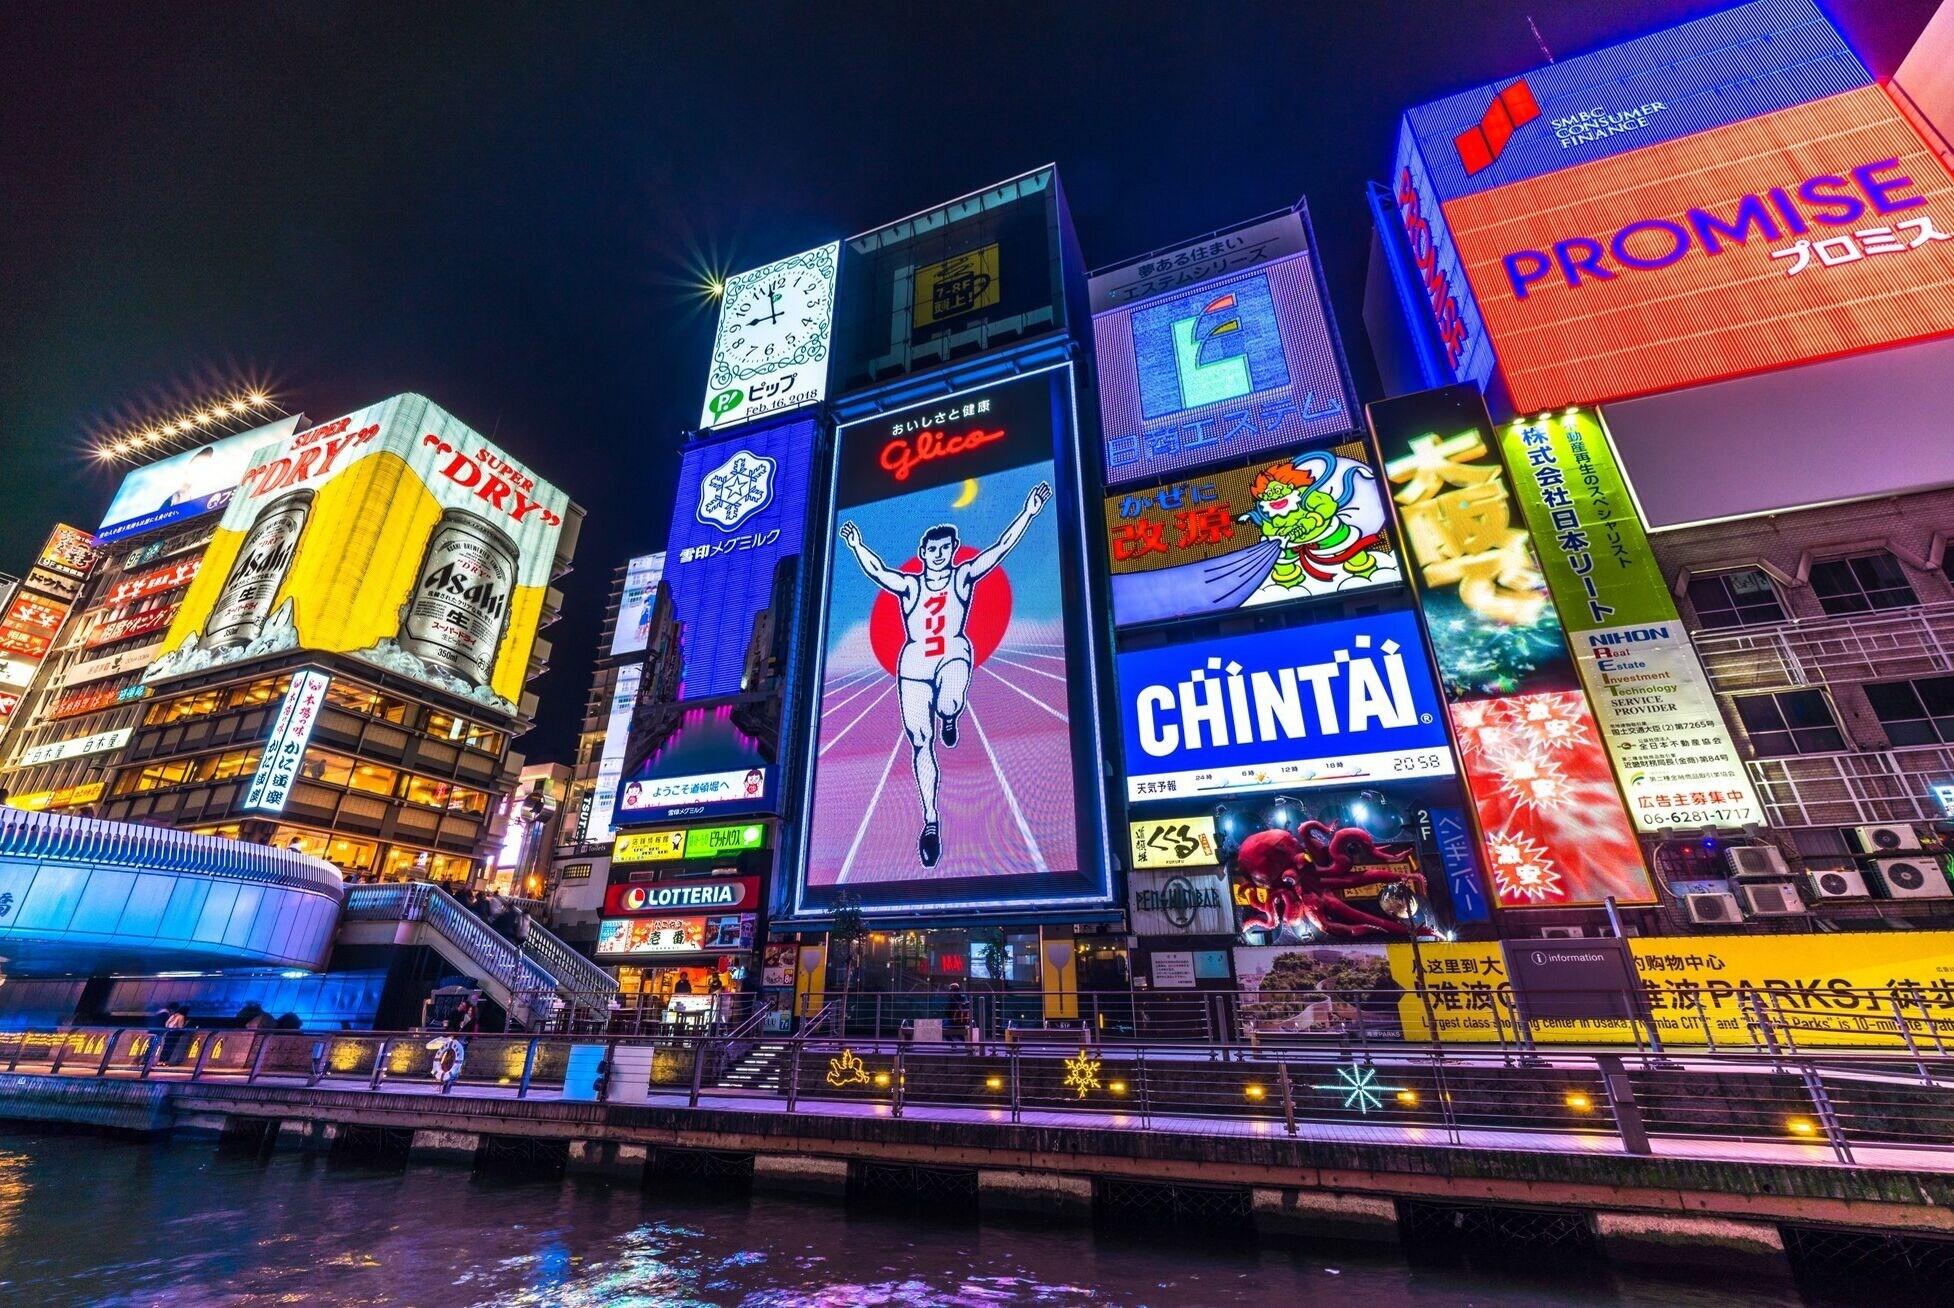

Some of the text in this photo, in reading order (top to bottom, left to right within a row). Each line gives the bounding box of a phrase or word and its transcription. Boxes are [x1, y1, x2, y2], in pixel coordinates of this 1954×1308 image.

[1551, 106, 1605, 130] SMBC
[1555, 101, 1668, 139] CONSUMER
[1561, 116, 1649, 149] FINANCE
[1501, 156, 1928, 299] PROMISE
[1771, 214, 1953, 277] プロミス
[1136, 236, 1245, 280] 夢ある住まい
[1123, 246, 1268, 301] エステムシリーズ
[1400, 166, 1469, 371] PROMISE
[771, 277, 786, 290] 12
[792, 276, 802, 288] 1
[803, 283, 817, 295] 2
[752, 288, 765, 301] 11
[806, 298, 821, 309] 3
[736, 302, 752, 319] 10
[729, 323, 742, 334] 9
[801, 316, 814, 327] 4
[731, 337, 746, 350] 8
[784, 332, 796, 345] 5
[745, 345, 759, 358] 7
[764, 343, 775, 356] 6
[749, 372, 798, 403] ピップ
[746, 400, 769, 417] Feb.
[789, 389, 818, 402] 2018
[891, 398, 991, 437] おいしさと健康
[291, 416, 352, 451] SUPER
[1107, 390, 1343, 468] 日商エステム
[475, 447, 535, 494] SUPER
[1110, 500, 1235, 562] 改源
[1520, 425, 1616, 624] 株式会社日本リート
[678, 528, 781, 565] 雪印メグミルク
[227, 541, 294, 588] Asahi
[237, 585, 258, 604] 生
[423, 561, 506, 620] Asahi
[445, 609, 471, 631] 生
[923, 591, 948, 658] グリコ
[431, 621, 477, 646] スーパードライ
[1588, 627, 1670, 647] NIHON
[437, 648, 458, 663] 350ml
[1593, 647, 1631, 660] Real
[1597, 659, 1646, 672] Estate
[1602, 671, 1671, 685] Investment
[1135, 634, 1419, 759] CHINTAI
[1604, 684, 1678, 697] Technology
[1611, 695, 1664, 708] SERVICE
[1614, 703, 1678, 717] PROVIDER
[84, 733, 120, 753] 白木屋
[1639, 737, 1723, 751] 全日本不動産協会
[265, 740, 301, 806] かに道楽
[652, 780, 730, 798] ようこそ道頓堀へ
[1136, 780, 1178, 795] 天気予報
[1638, 789, 1744, 809] 広告主募集中
[1643, 808, 1751, 825] 06-6281-1717
[709, 829, 741, 848] ピタットハウス
[1147, 825, 1200, 859] くくる
[1438, 815, 1480, 911] ペンギンバー
[648, 885, 733, 906] LOTTERIA
[649, 929, 685, 946] 壱番
[1549, 952, 1605, 962] information
[1421, 1016, 1461, 1031] Lrgest
[1463, 1016, 1491, 1029] class
[1717, 1017, 1738, 1030] and
[1838, 1018, 1851, 1030] is
